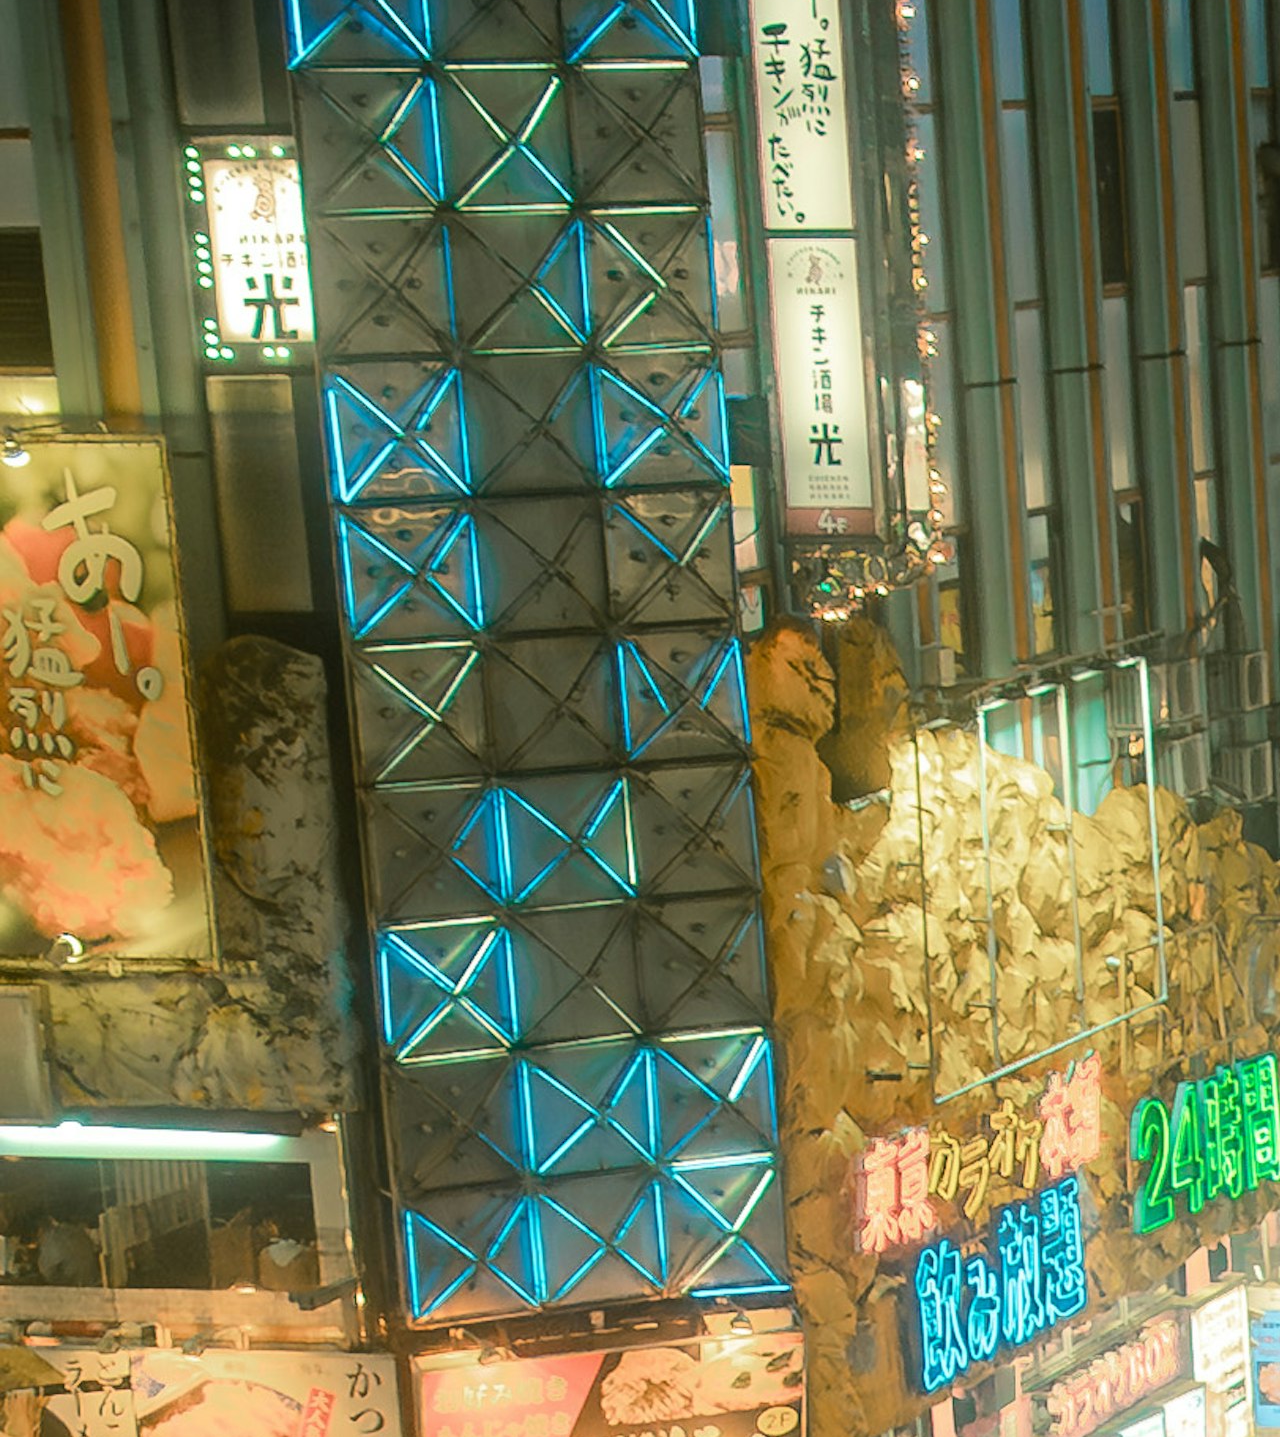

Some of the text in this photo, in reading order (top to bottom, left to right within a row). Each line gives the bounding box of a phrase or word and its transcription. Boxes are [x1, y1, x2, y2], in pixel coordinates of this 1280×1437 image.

[800, 39, 837, 138] 猛烈に
[243, 273, 299, 340] 光
[810, 304, 834, 415] チキン酒場
[808, 422, 843, 466] 光
[766, 1412, 791, 1430] 2F
